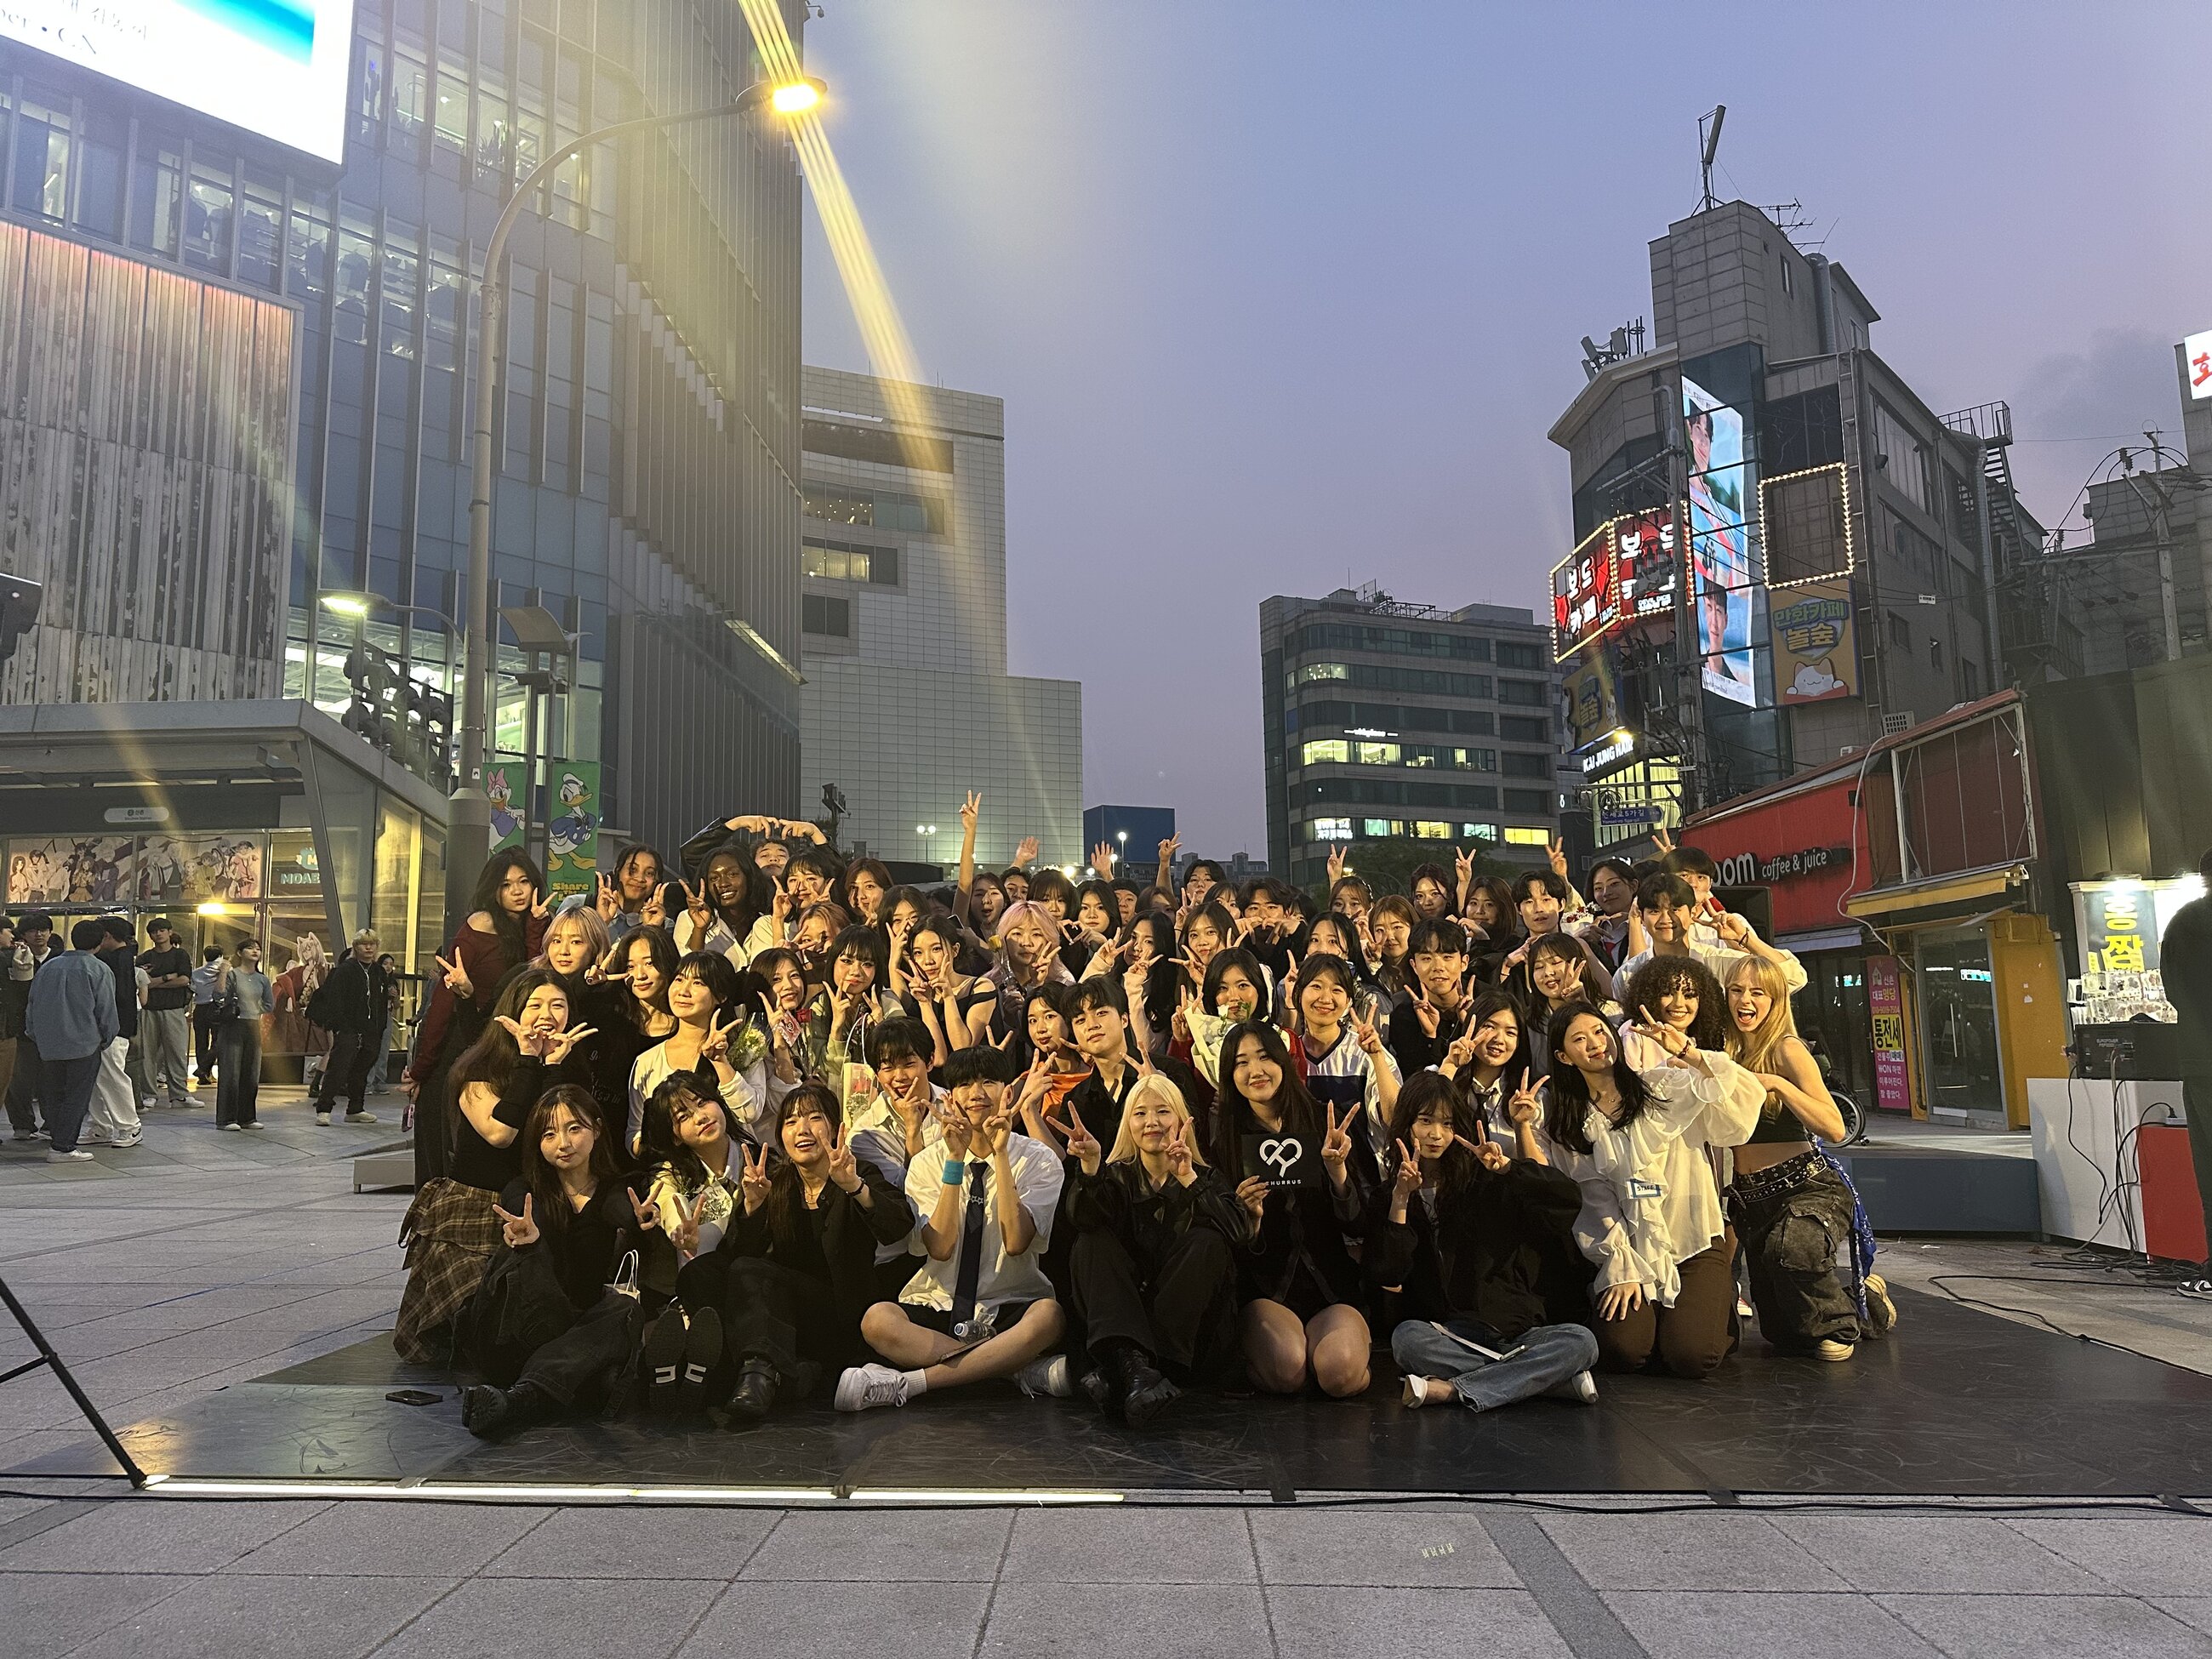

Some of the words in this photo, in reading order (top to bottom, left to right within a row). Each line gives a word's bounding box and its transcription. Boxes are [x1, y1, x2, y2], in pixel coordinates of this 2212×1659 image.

[1568, 557, 1593, 599] 보드
[1570, 595, 1598, 634] 카페
[1772, 601, 1845, 628] 만화카페
[1787, 622, 1834, 651] 놀숲
[1583, 755, 1595, 772] KAI
[1596, 745, 1616, 767] JUNG
[1761, 856, 1791, 881] coffee
[1793, 853, 1800, 871] &
[1803, 847, 1827, 875] juice
[552, 882, 590, 891] Share
[1884, 974, 1895, 986] 신촌
[1874, 1017, 1902, 1049] 통전세
